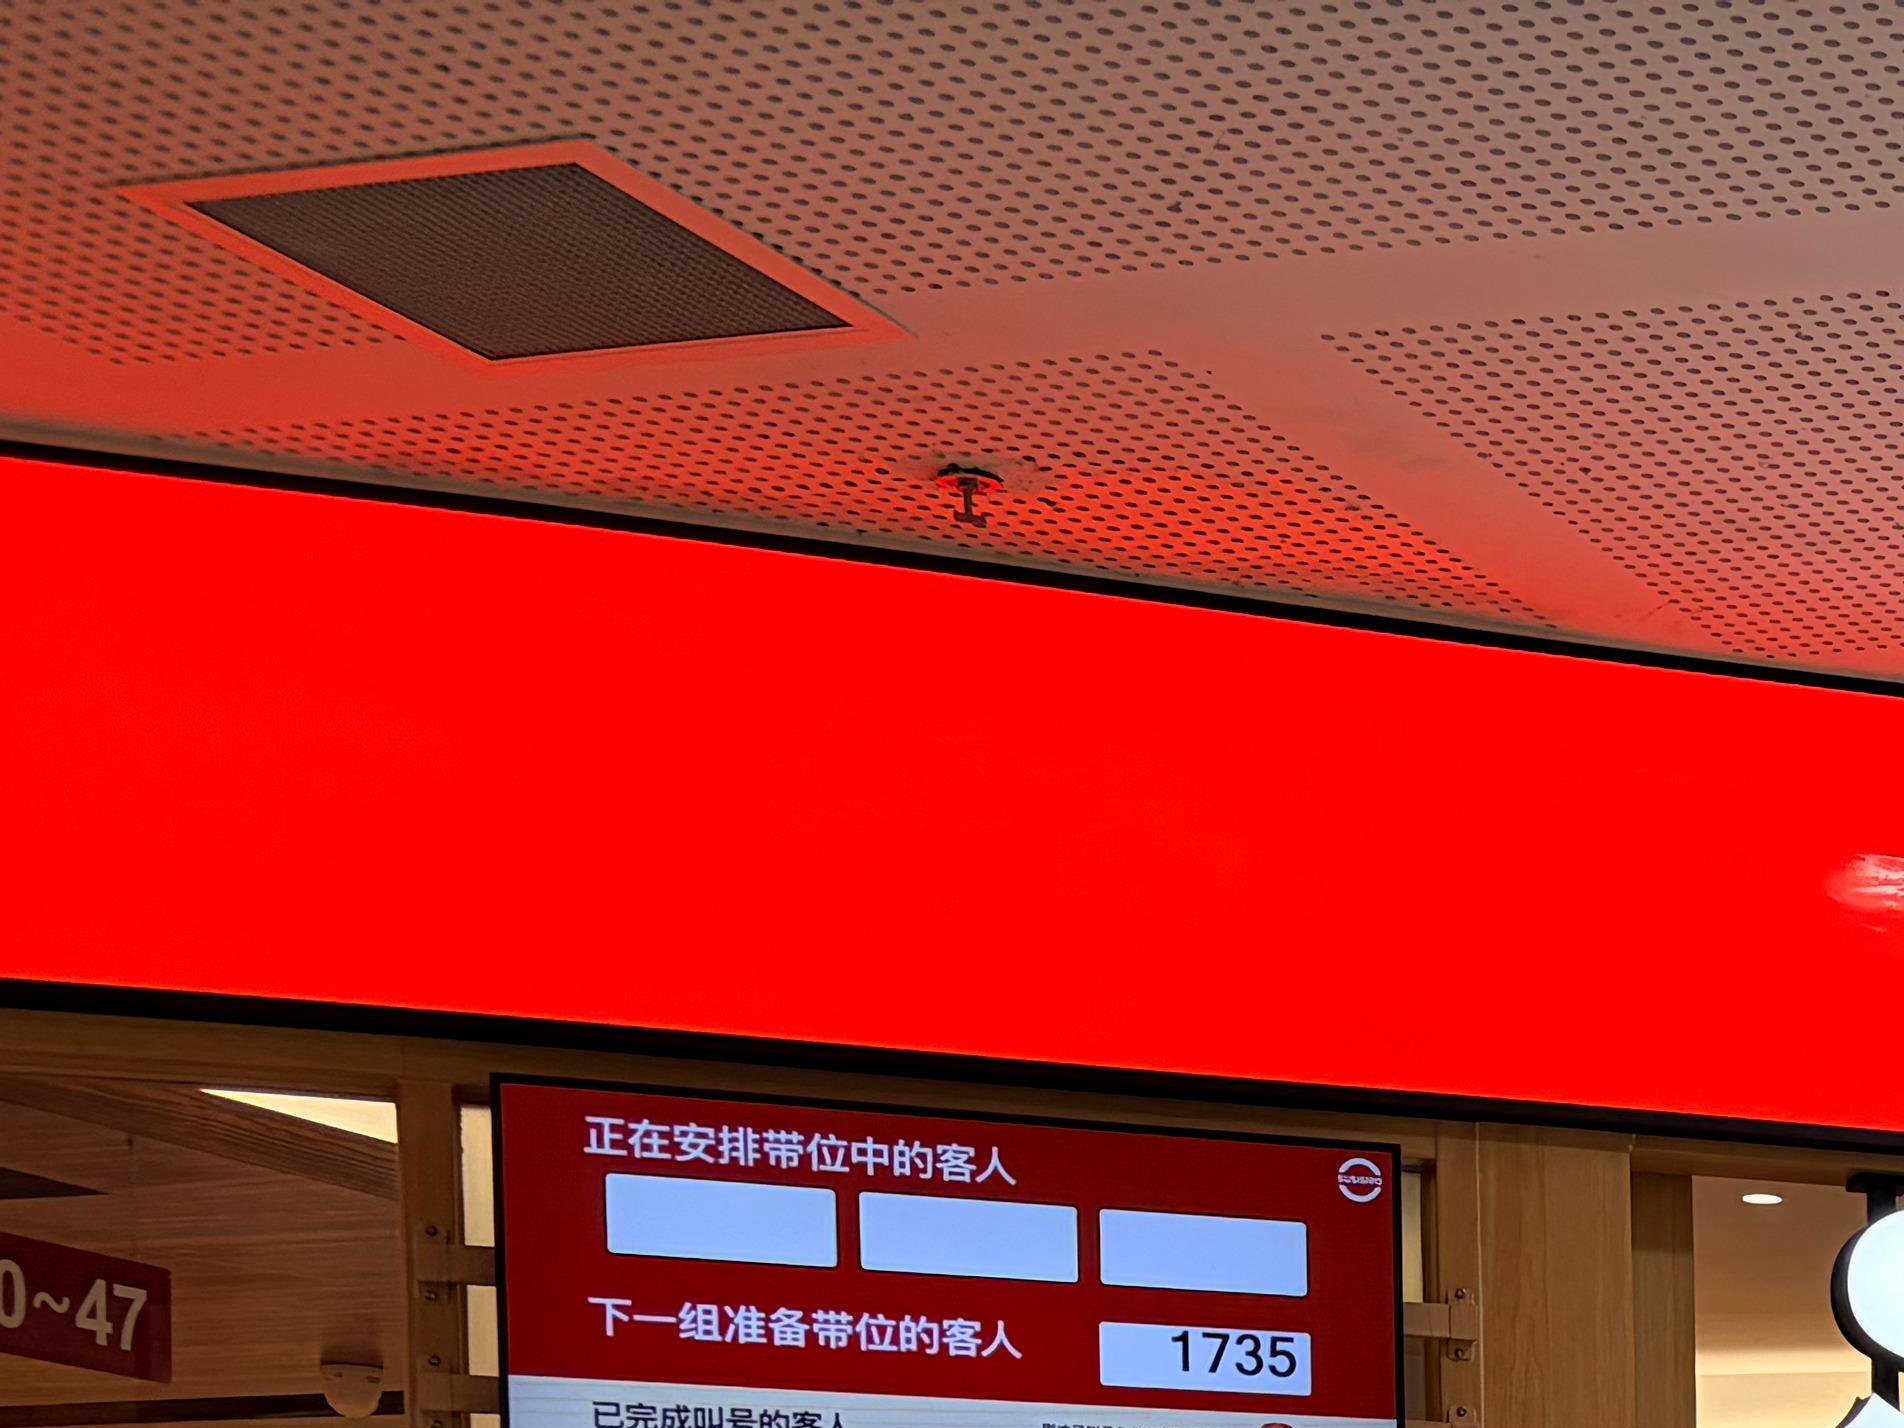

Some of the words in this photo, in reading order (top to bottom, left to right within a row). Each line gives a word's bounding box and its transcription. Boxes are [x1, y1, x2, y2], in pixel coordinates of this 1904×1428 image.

[584, 1116, 1016, 1187] 正在安排带位中的客人
[588, 1296, 1022, 1362] 下一组准备带位的客人
[1170, 1331, 1299, 1380] 1735
